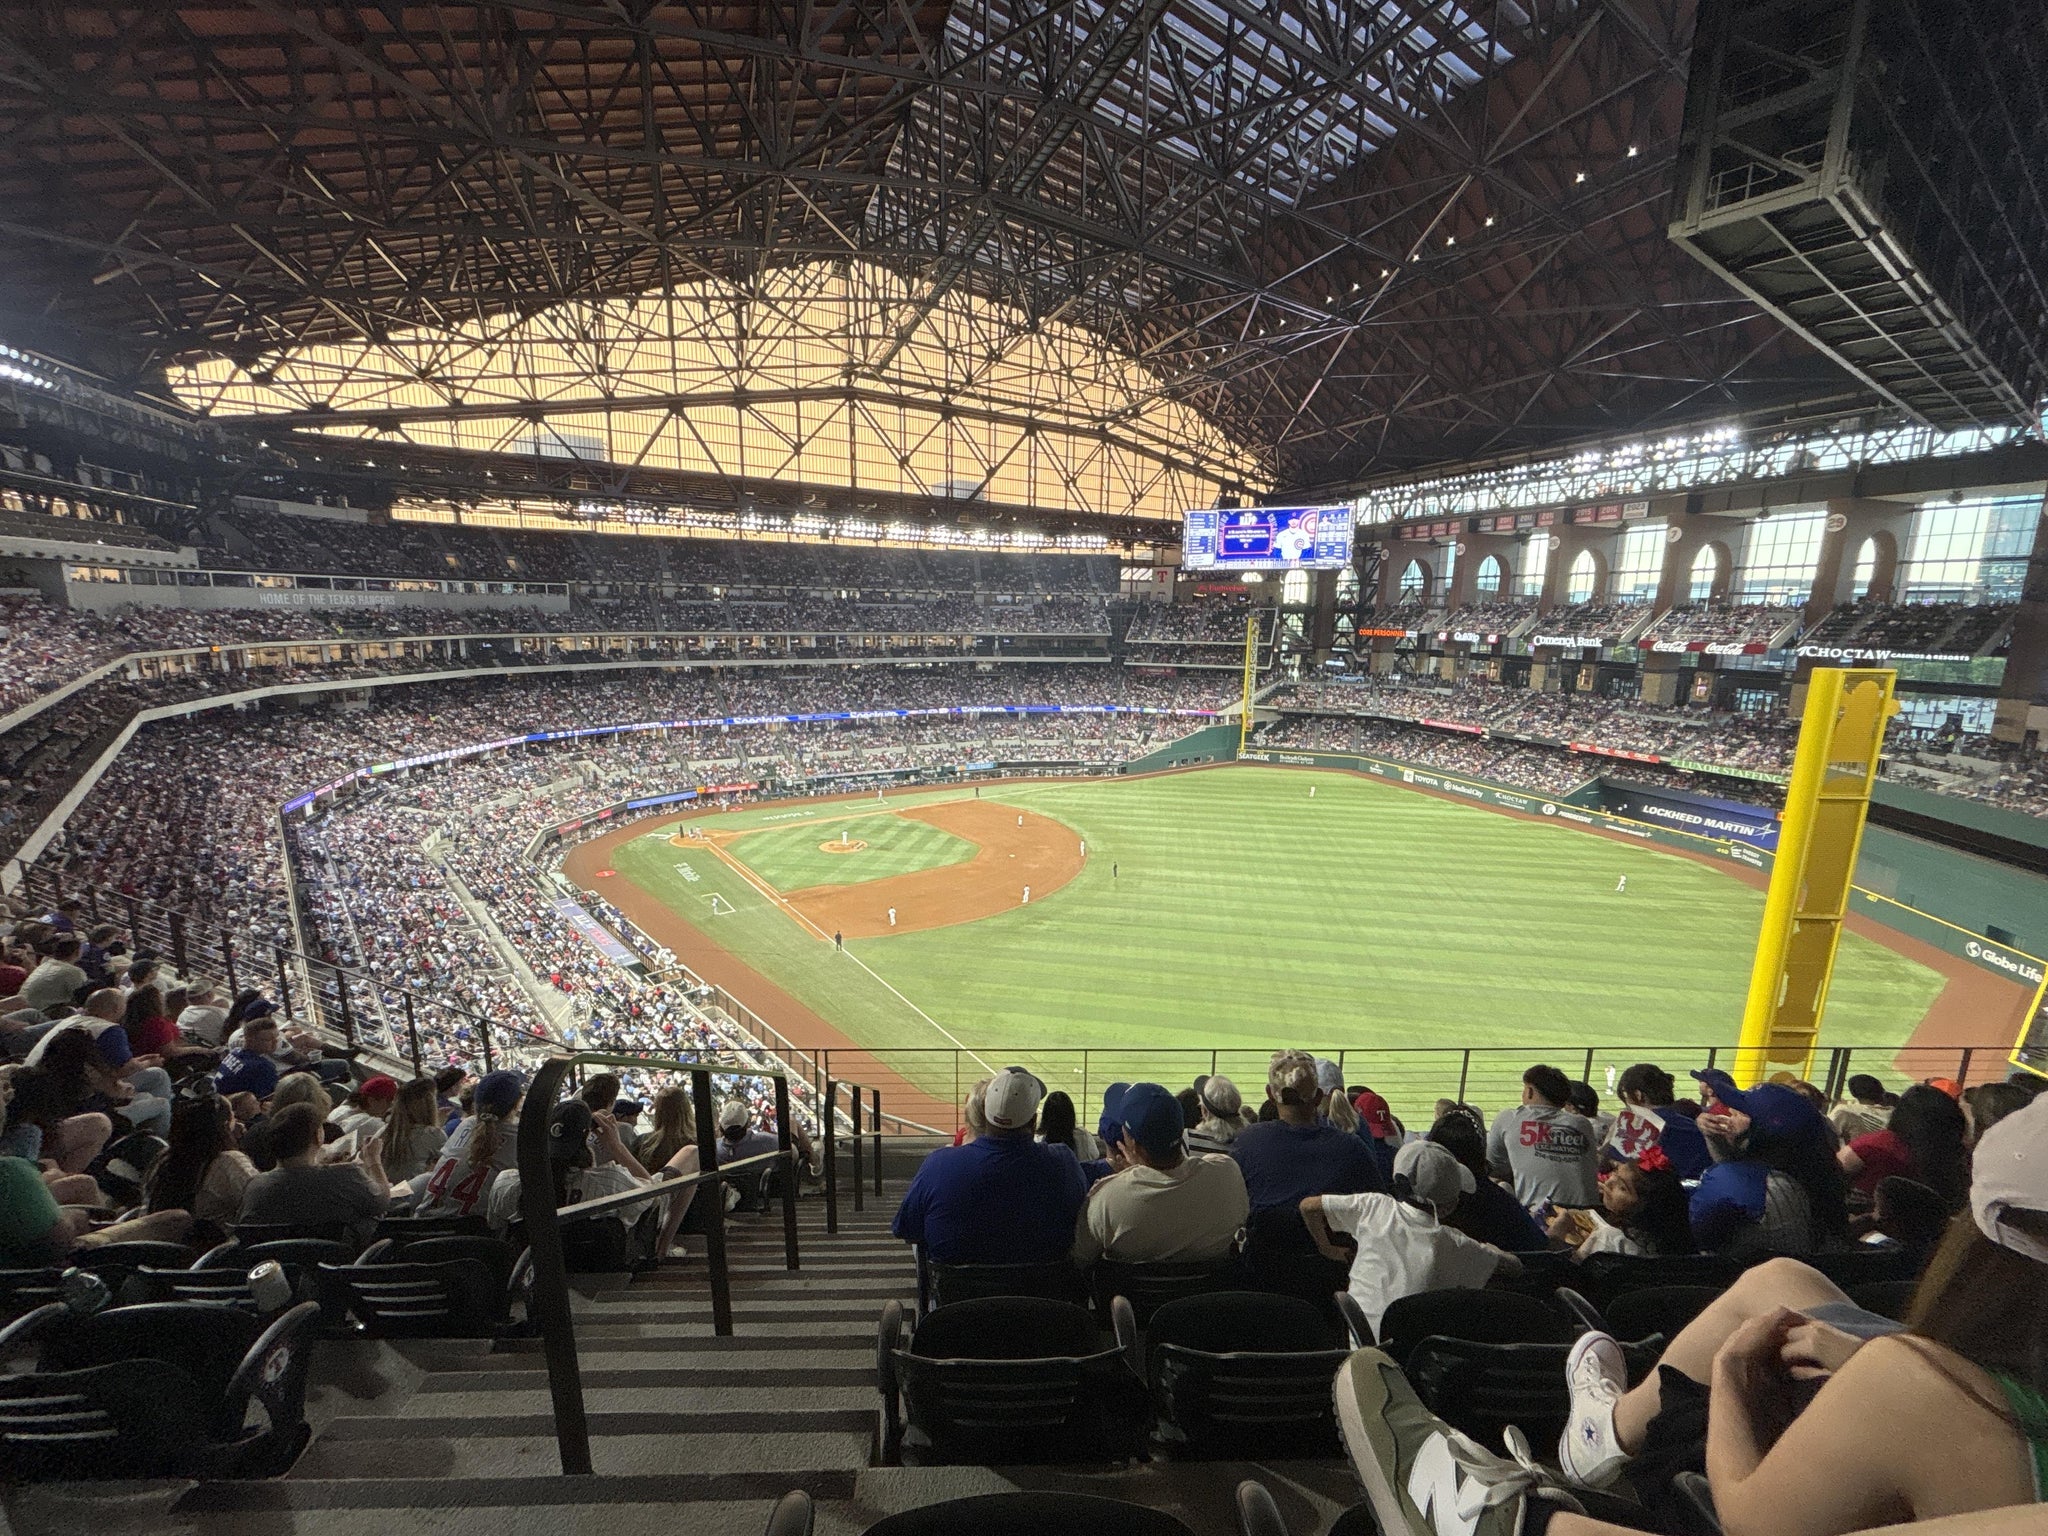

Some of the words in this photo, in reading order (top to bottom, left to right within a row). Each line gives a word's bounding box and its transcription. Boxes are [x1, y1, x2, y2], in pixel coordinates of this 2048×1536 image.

[1576, 508, 1592, 516] 2015
[1601, 505, 1618, 514] 2016
[1828, 516, 1844, 528] 29
[259, 593, 290, 605] HOME
[293, 593, 306, 605] OF
[308, 594, 326, 605] THE
[329, 594, 356, 606] TEXAS
[358, 594, 396, 606] RANGERS
[1358, 628, 1373, 636] CORE
[1374, 629, 1406, 637] PERSONNEL
[1577, 637, 1603, 647] Bank
[1806, 645, 1892, 660] CHOCTAW
[1933, 654, 1970, 662] RESORTS
[1238, 752, 1270, 761] SEATGEEK
[1415, 775, 1438, 786] TOYOTA
[1722, 766, 1784, 783] STAFFING
[1642, 805, 1703, 825] LOCKHEED
[1704, 818, 1755, 836] MARTIN
[1982, 949, 2018, 973] Globe
[2018, 964, 2043, 983] Life
[1376, 1110, 1386, 1122] T
[1520, 1120, 1553, 1147] 5K
[427, 1157, 491, 1216] 44
